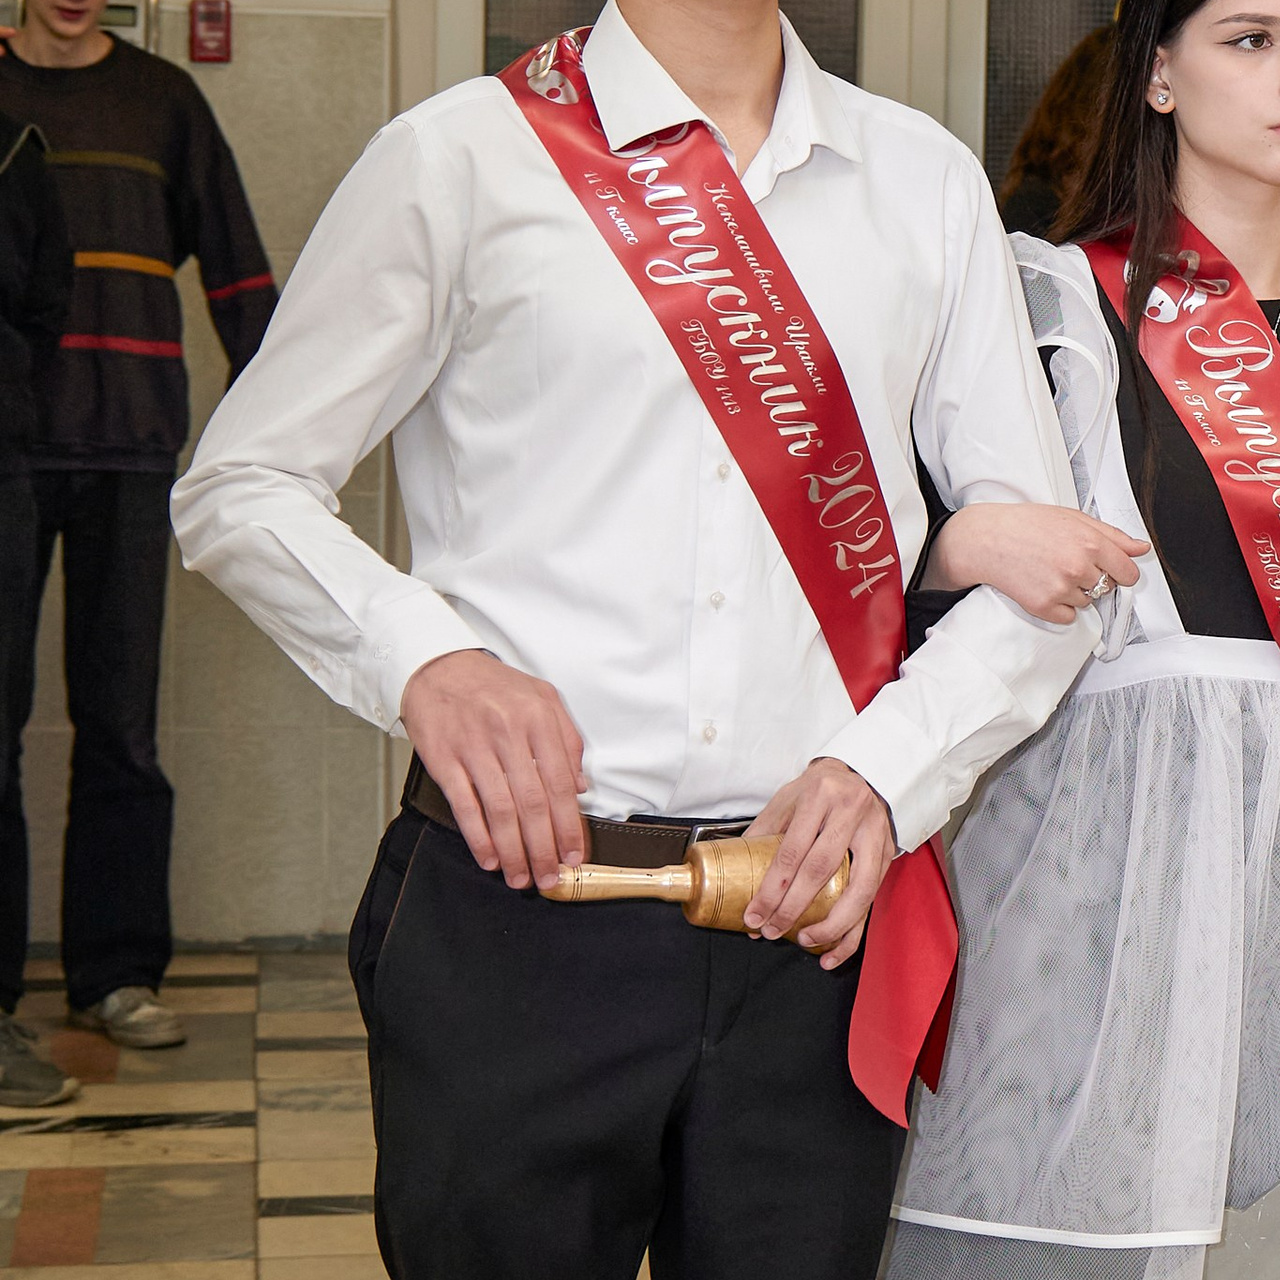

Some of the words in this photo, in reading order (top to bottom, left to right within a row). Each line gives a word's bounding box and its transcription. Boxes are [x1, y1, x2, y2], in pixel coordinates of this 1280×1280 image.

[583, 171, 602, 185] 11
[606, 206, 639, 245] класс
[680, 319, 730, 380] ГБОУ
[715, 384, 741, 415] 1413
[783, 316, 828, 395] Иракли
[1174, 378, 1192, 391] 11
[1193, 411, 1221, 447] класс
[800, 451, 896, 600] 2024
